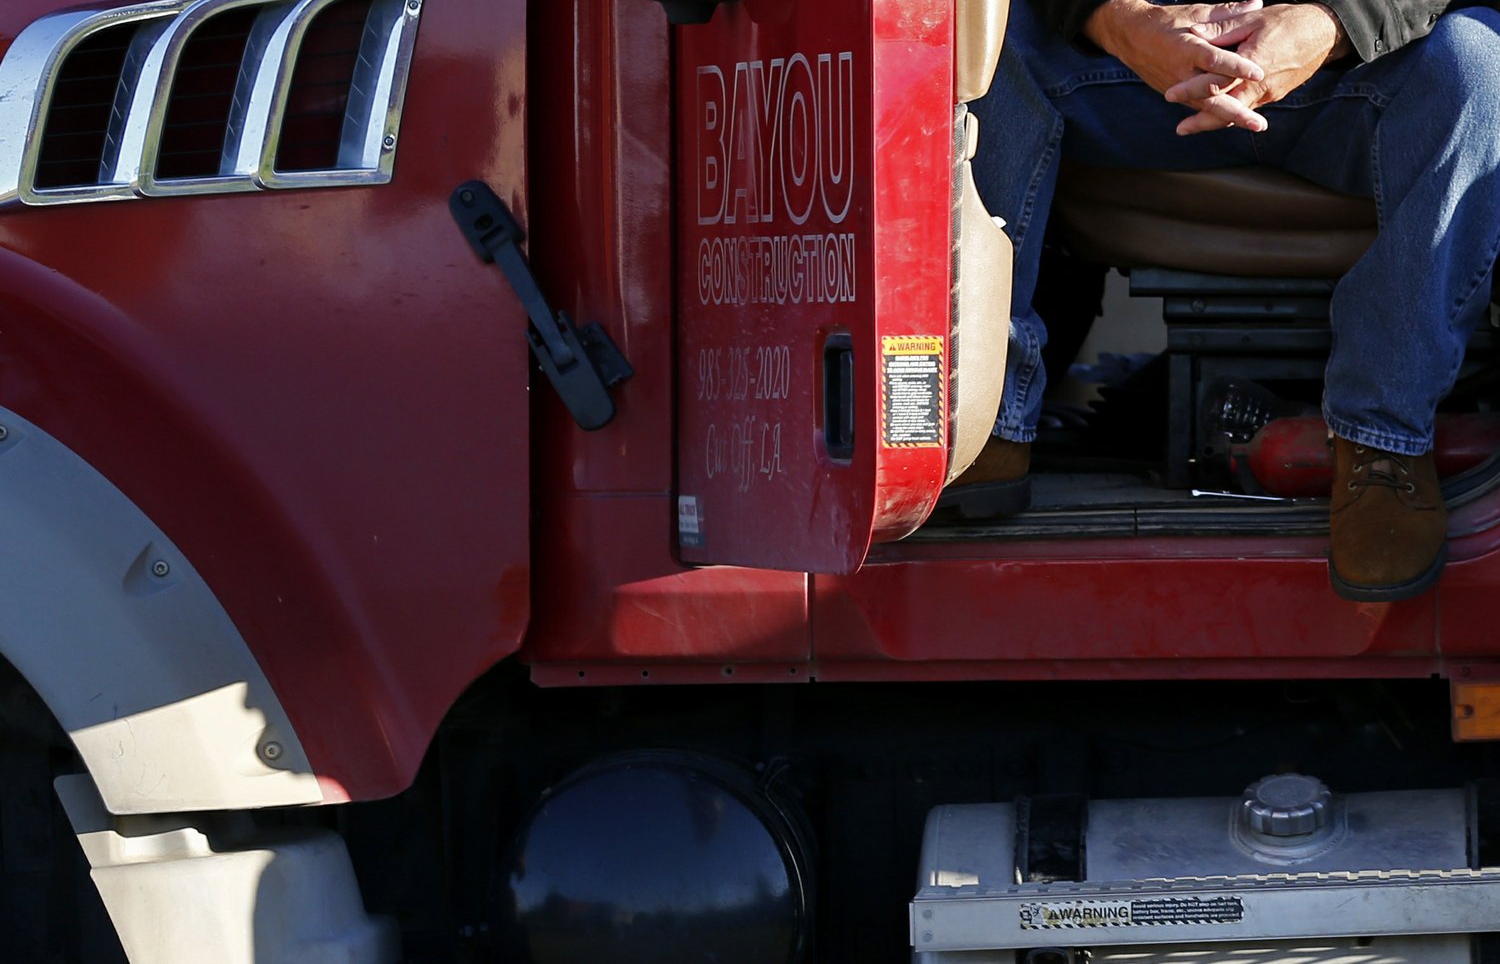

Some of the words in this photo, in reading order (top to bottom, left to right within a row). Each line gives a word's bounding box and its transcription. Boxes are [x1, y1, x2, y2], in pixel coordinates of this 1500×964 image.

[697, 51, 854, 226] BAYOU
[697, 232, 856, 306] CONSTRUCTION
[698, 345, 791, 401] 985-325-2020
[897, 341, 936, 352] WARNING
[760, 422, 782, 481] LA
[1058, 906, 1129, 921] WARNING
